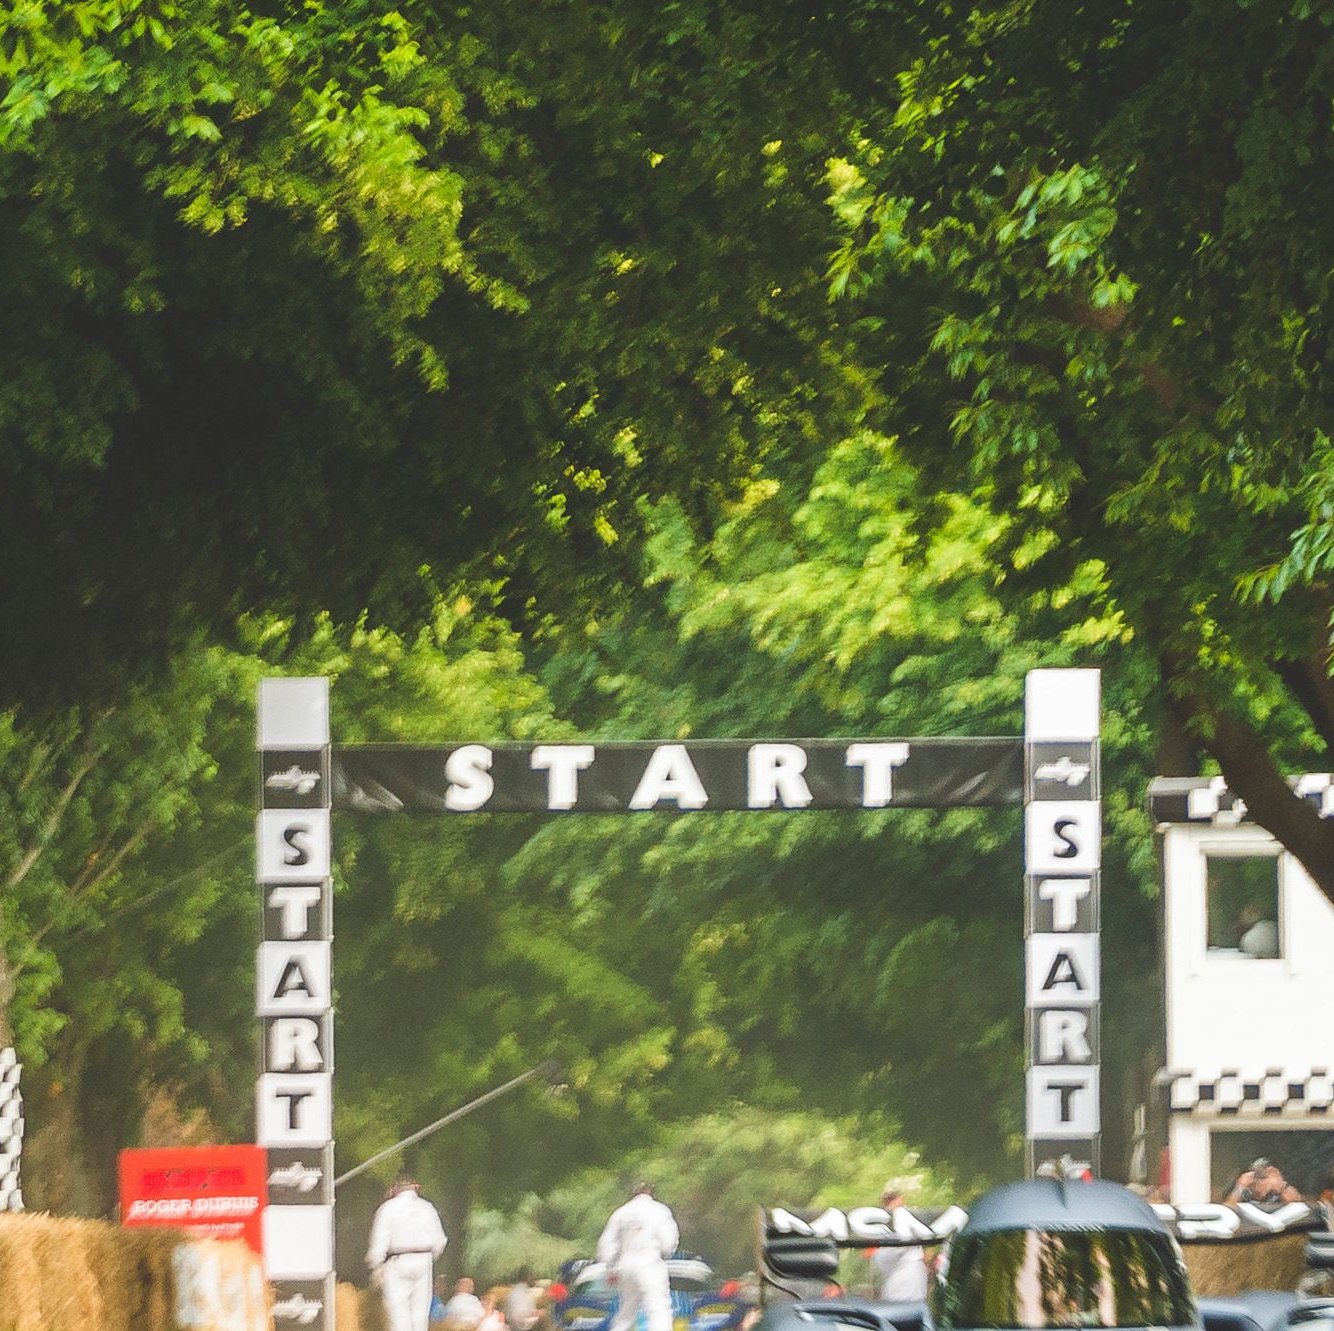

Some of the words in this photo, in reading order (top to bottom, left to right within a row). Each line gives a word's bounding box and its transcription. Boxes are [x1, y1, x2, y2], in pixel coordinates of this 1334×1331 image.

[444, 744, 910, 812] START
[269, 826, 323, 1130] START
[1038, 820, 1092, 1123] START
[132, 1199, 193, 1216] ROGER
